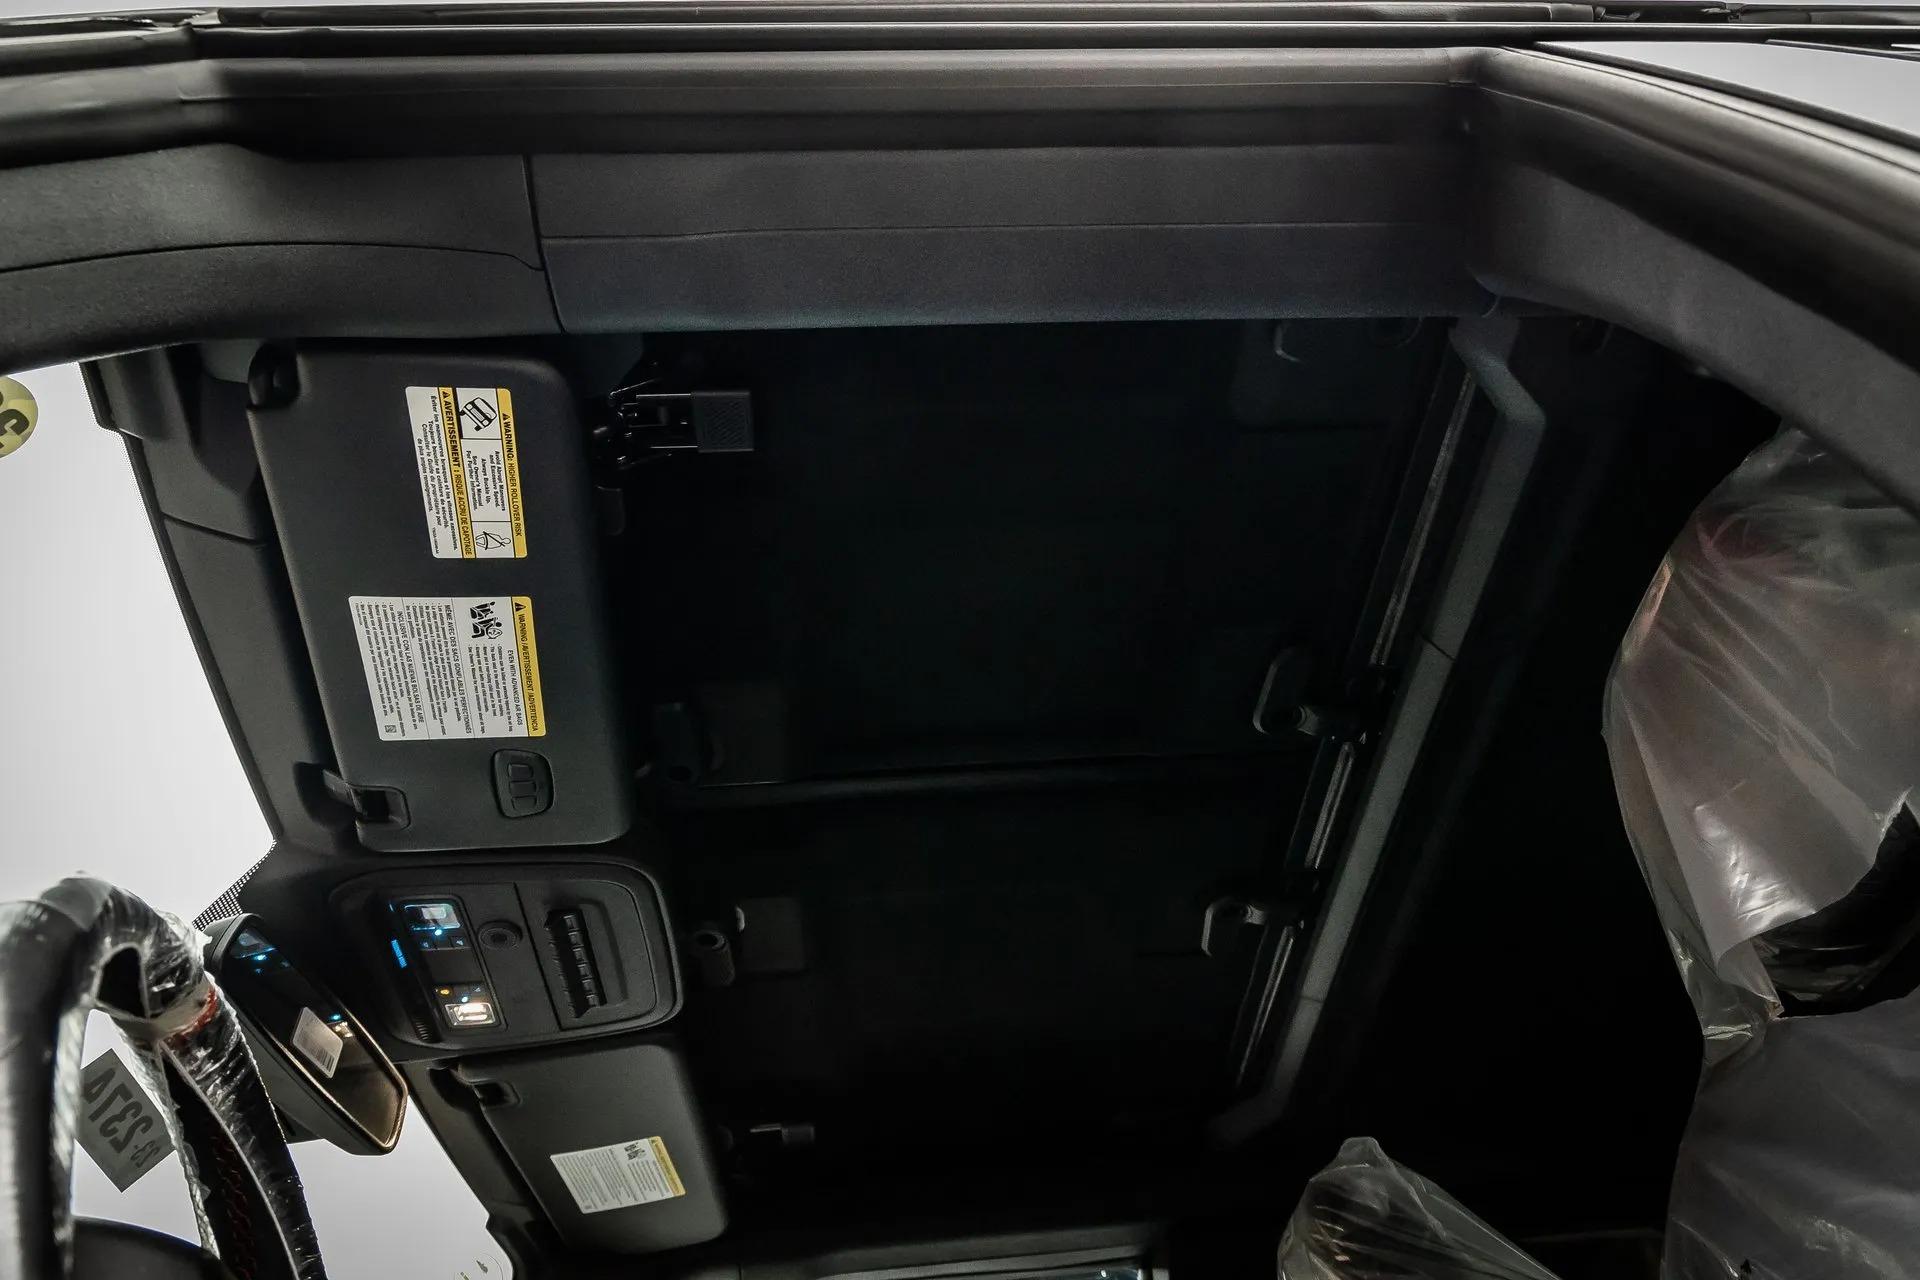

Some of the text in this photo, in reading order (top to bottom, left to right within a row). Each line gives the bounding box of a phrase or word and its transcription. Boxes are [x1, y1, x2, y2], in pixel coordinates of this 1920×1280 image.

[443, 401, 460, 467] AVERTISSEMENT
[480, 458, 488, 477] Always
[454, 474, 464, 495] RISQUE
[503, 421, 522, 537] WARNING: HIGHER ROLLOVER RISK
[457, 496, 467, 516] ACCRU
[460, 517, 468, 525] DE
[461, 526, 472, 555] CAPOTAGE
[396, 611, 409, 639] INCLUSIVE
[517, 614, 528, 642] WARNING
[402, 640, 411, 652] CON
[404, 652, 413, 662] LAS
[507, 650, 515, 663] EVEN
[406, 663, 417, 683] NUEVAS
[444, 605, 472, 734] MÊME AVEC DES SACS GONFLABLES PERFECTIONNÉS
[509, 664, 517, 676] WITH
[411, 684, 421, 704] BOLSAS
[511, 678, 520, 703] ADVANCED
[415, 704, 422, 712] DE
[416, 712, 425, 723] AIRE
[515, 712, 523, 726] BAGS
